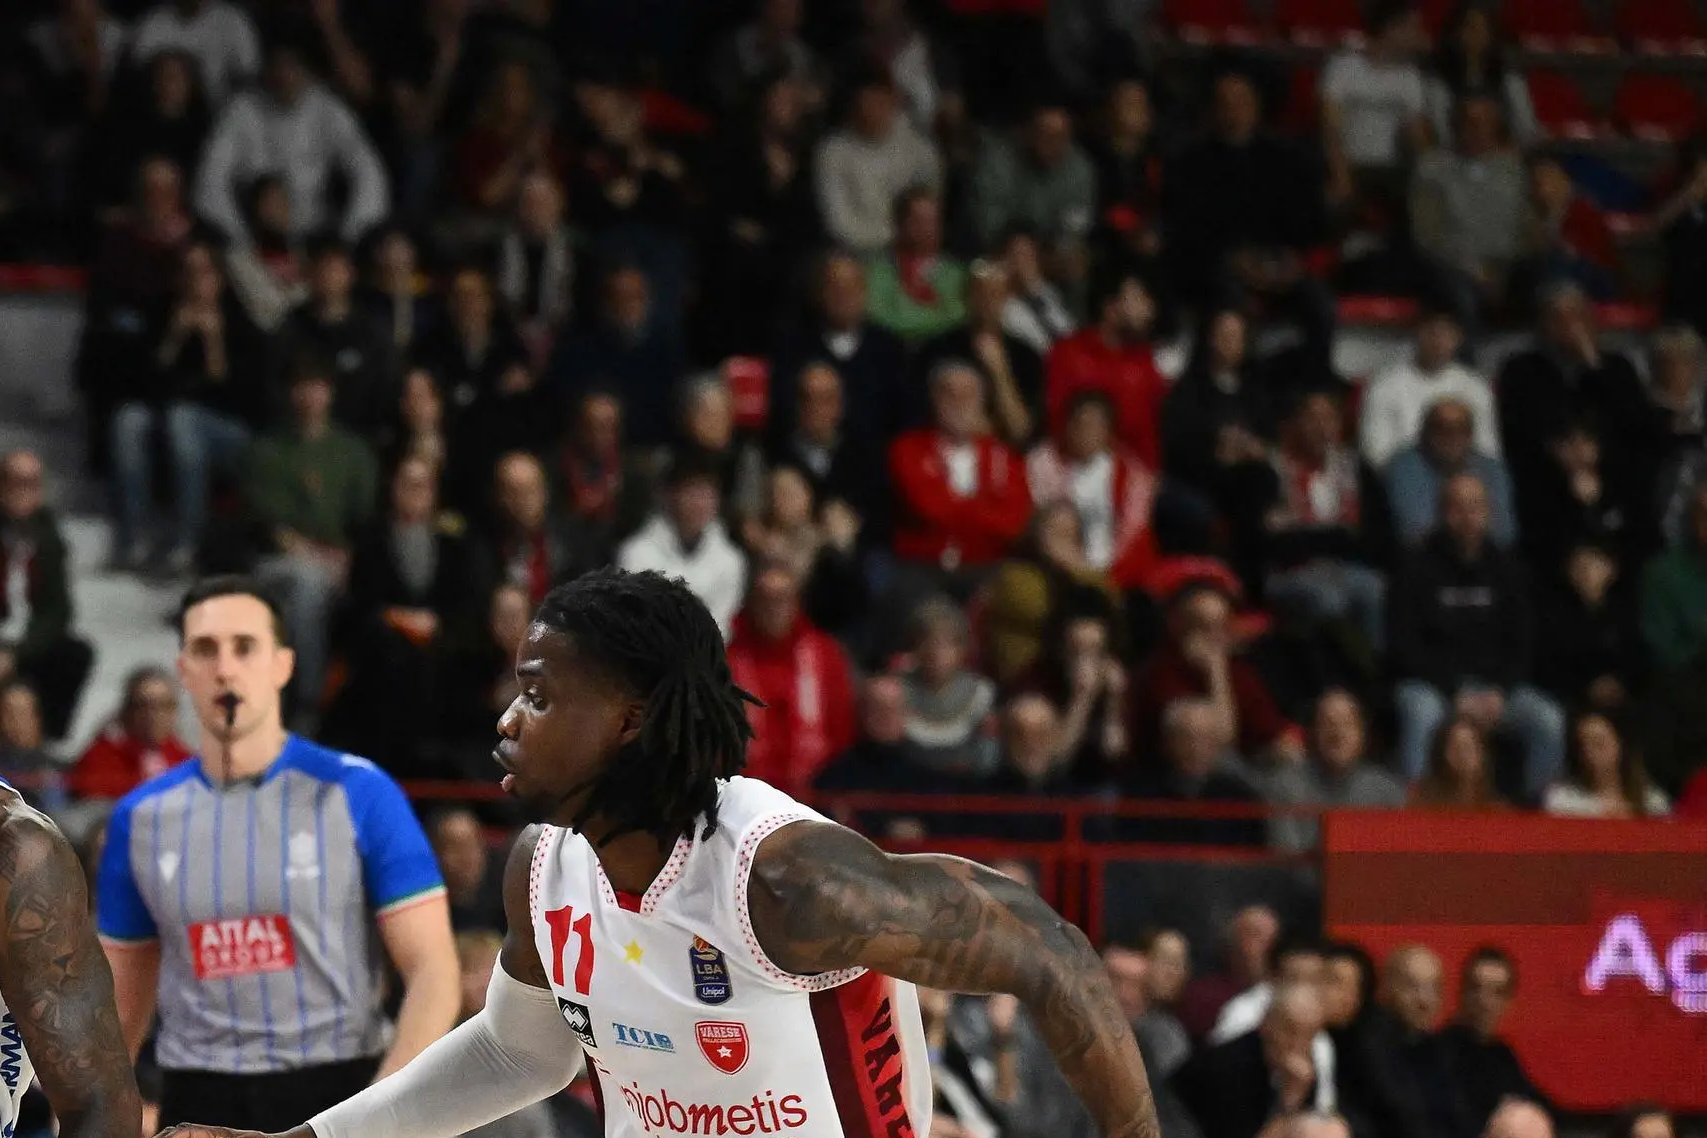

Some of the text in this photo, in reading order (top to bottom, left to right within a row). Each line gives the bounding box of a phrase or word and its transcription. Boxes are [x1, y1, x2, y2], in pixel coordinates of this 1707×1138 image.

[544, 905, 595, 996] 11
[696, 964, 723, 974] LBA
[703, 986, 725, 997] Unipol
[699, 1026, 742, 1038] VARESE
